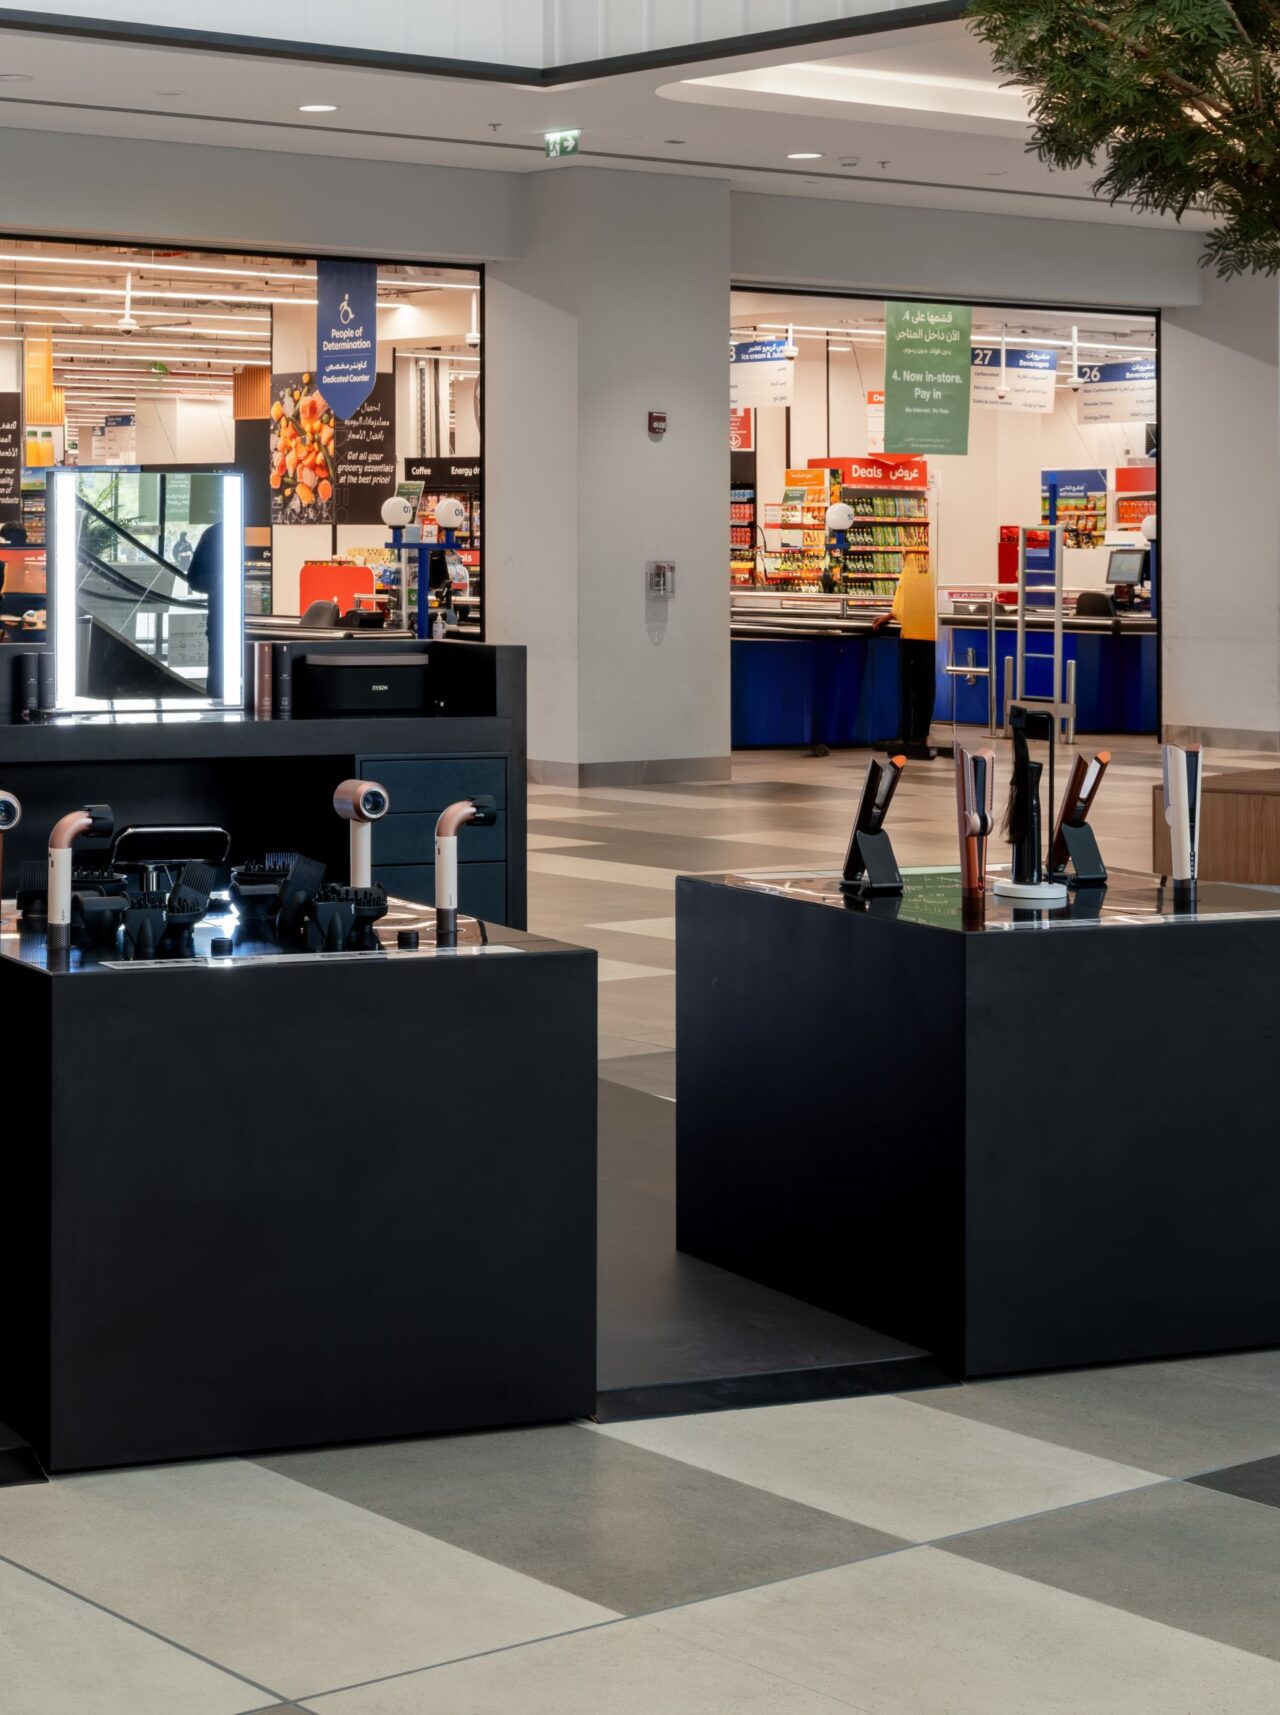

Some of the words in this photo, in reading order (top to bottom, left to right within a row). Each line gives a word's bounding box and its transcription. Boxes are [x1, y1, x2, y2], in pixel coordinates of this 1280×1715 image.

[331, 328, 354, 340] People
[355, 326, 363, 337] of
[323, 339, 371, 351] Determination
[974, 350, 992, 365] 27
[1019, 360, 1049, 368] Beverages
[322, 375, 349, 383] Dedicated
[350, 374, 370, 382] Counter
[903, 370, 924, 382] Now
[925, 371, 963, 384] in-store.
[1082, 366, 1100, 382] 26
[914, 388, 931, 402] Pay
[933, 388, 942, 400] in
[347, 451, 358, 460] Get
[359, 451, 367, 460] all
[368, 453, 384, 463] your
[337, 464, 363, 475] grocery
[363, 463, 394, 473] essentials
[411, 466, 432, 476] Coffee
[451, 466, 473, 477] Energy
[473, 466, 481, 475] dr
[851, 465, 882, 478] Deals
[889, 465, 919, 480] عروض
[339, 475, 347, 484] at
[347, 475, 358, 484] the
[358, 475, 371, 484] best
[371, 475, 391, 486] price!
[6, 486, 13, 494] of
[454, 508, 464, 517] 08
[461, 553, 472, 562] als
